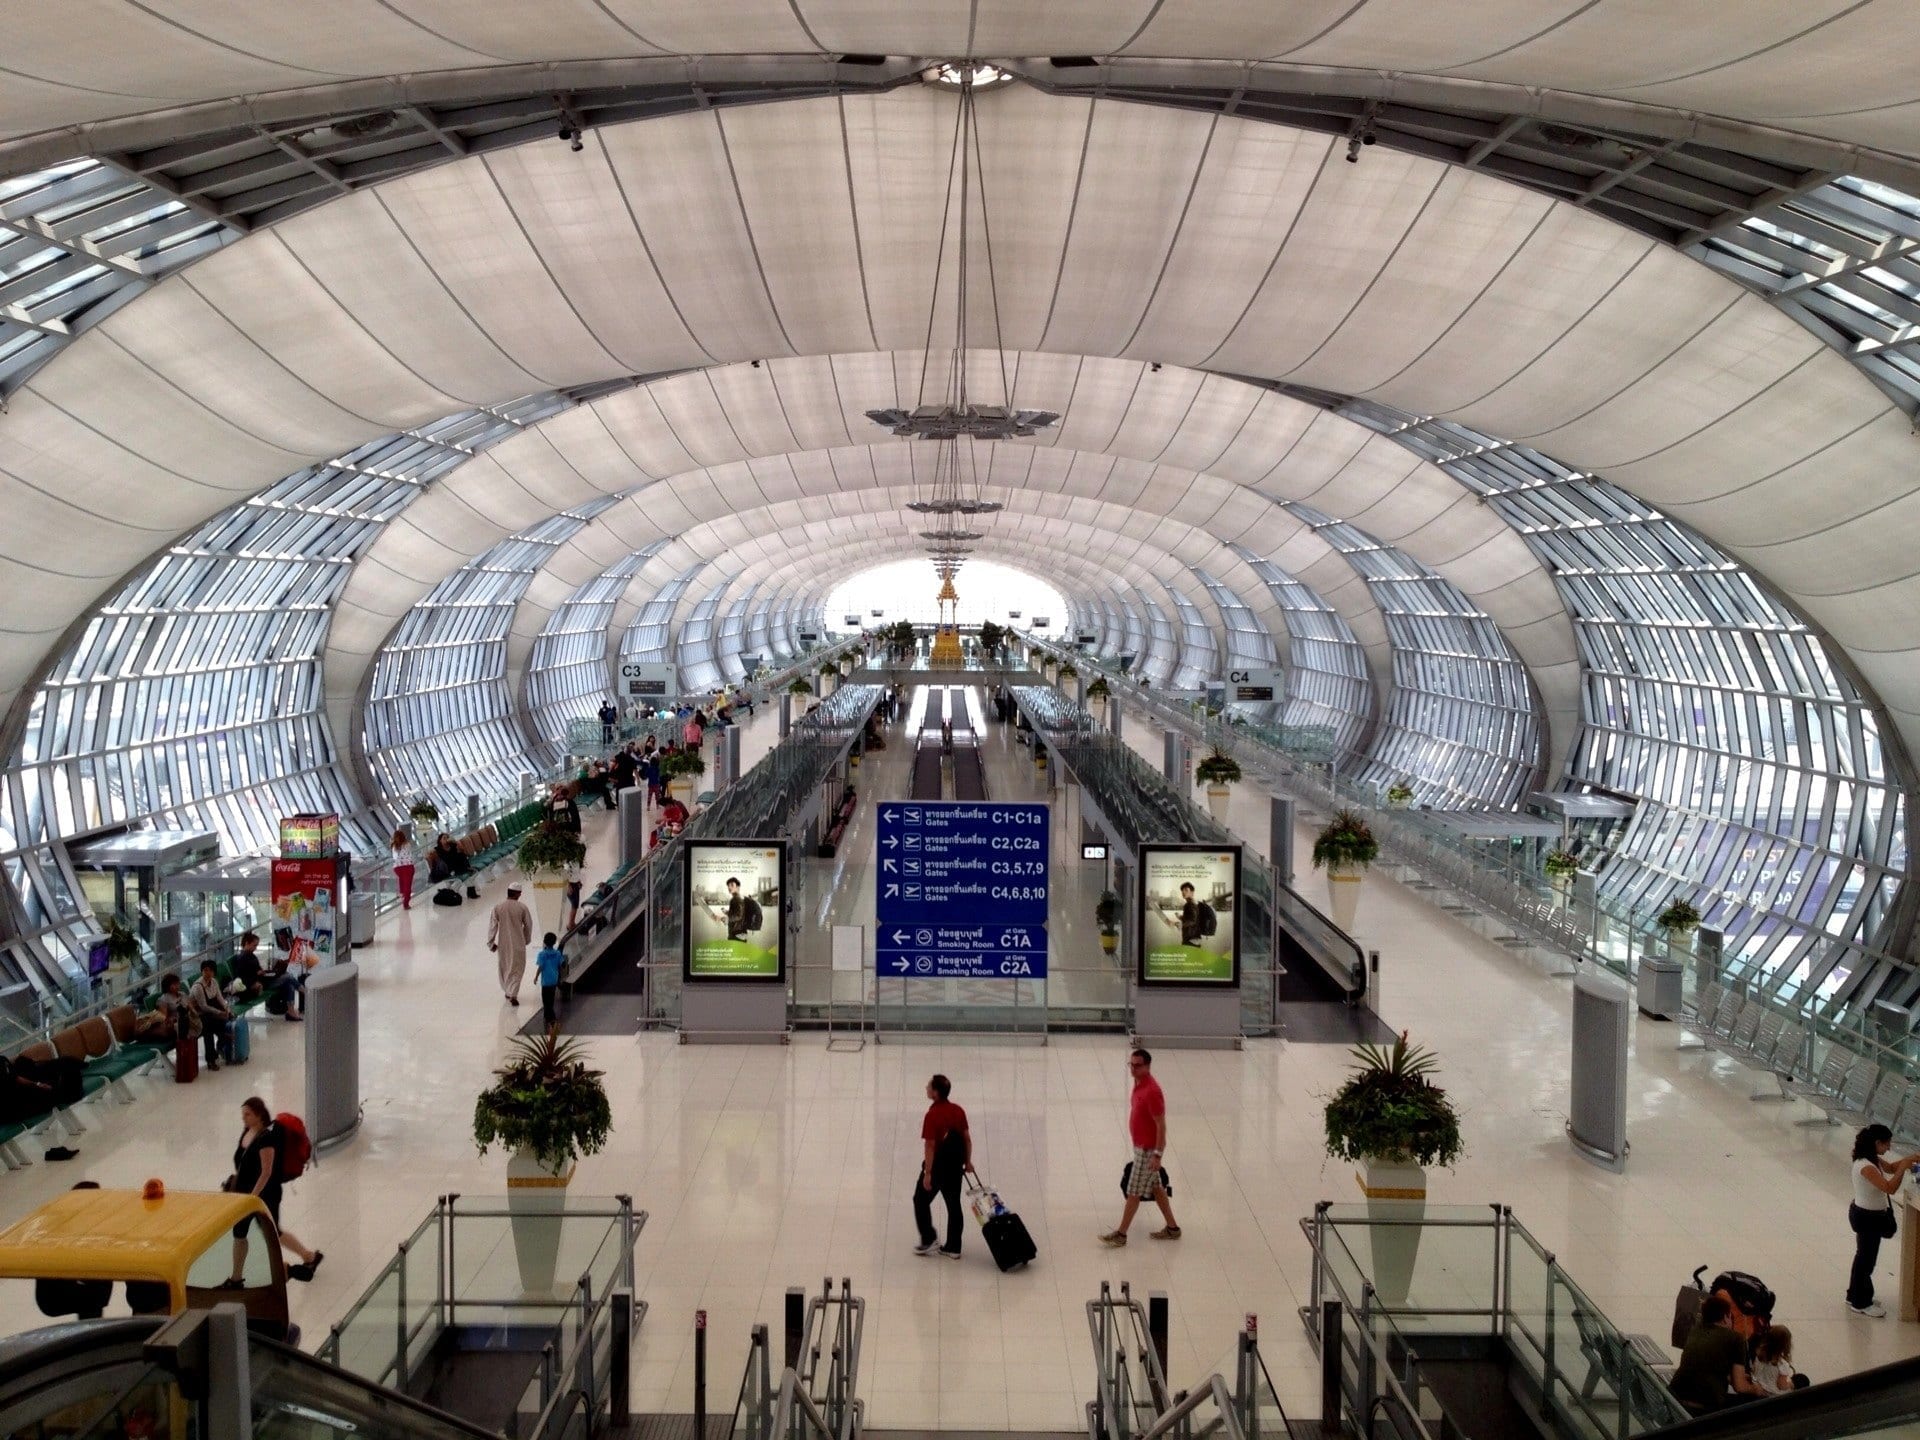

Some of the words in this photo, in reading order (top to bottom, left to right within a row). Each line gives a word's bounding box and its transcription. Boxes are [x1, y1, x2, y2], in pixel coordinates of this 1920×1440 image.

[622, 665, 641, 677] C3
[1230, 671, 1249, 683] C4
[925, 819, 948, 827] Gates
[992, 812, 1041, 824] C1-C1a
[991, 837, 1040, 851] C2,C2a
[1742, 849, 1785, 862] FIST
[925, 869, 948, 877] Gates
[991, 862, 1044, 876] C3,5,7,9
[925, 894, 948, 902] Gates
[991, 887, 1045, 901] C4,6,8,10
[937, 941, 970, 949] Smoking
[1000, 934, 1032, 947] C1A
[937, 968, 970, 977] Smoking
[972, 968, 994, 976] Room
[1000, 961, 1032, 975] C2A
